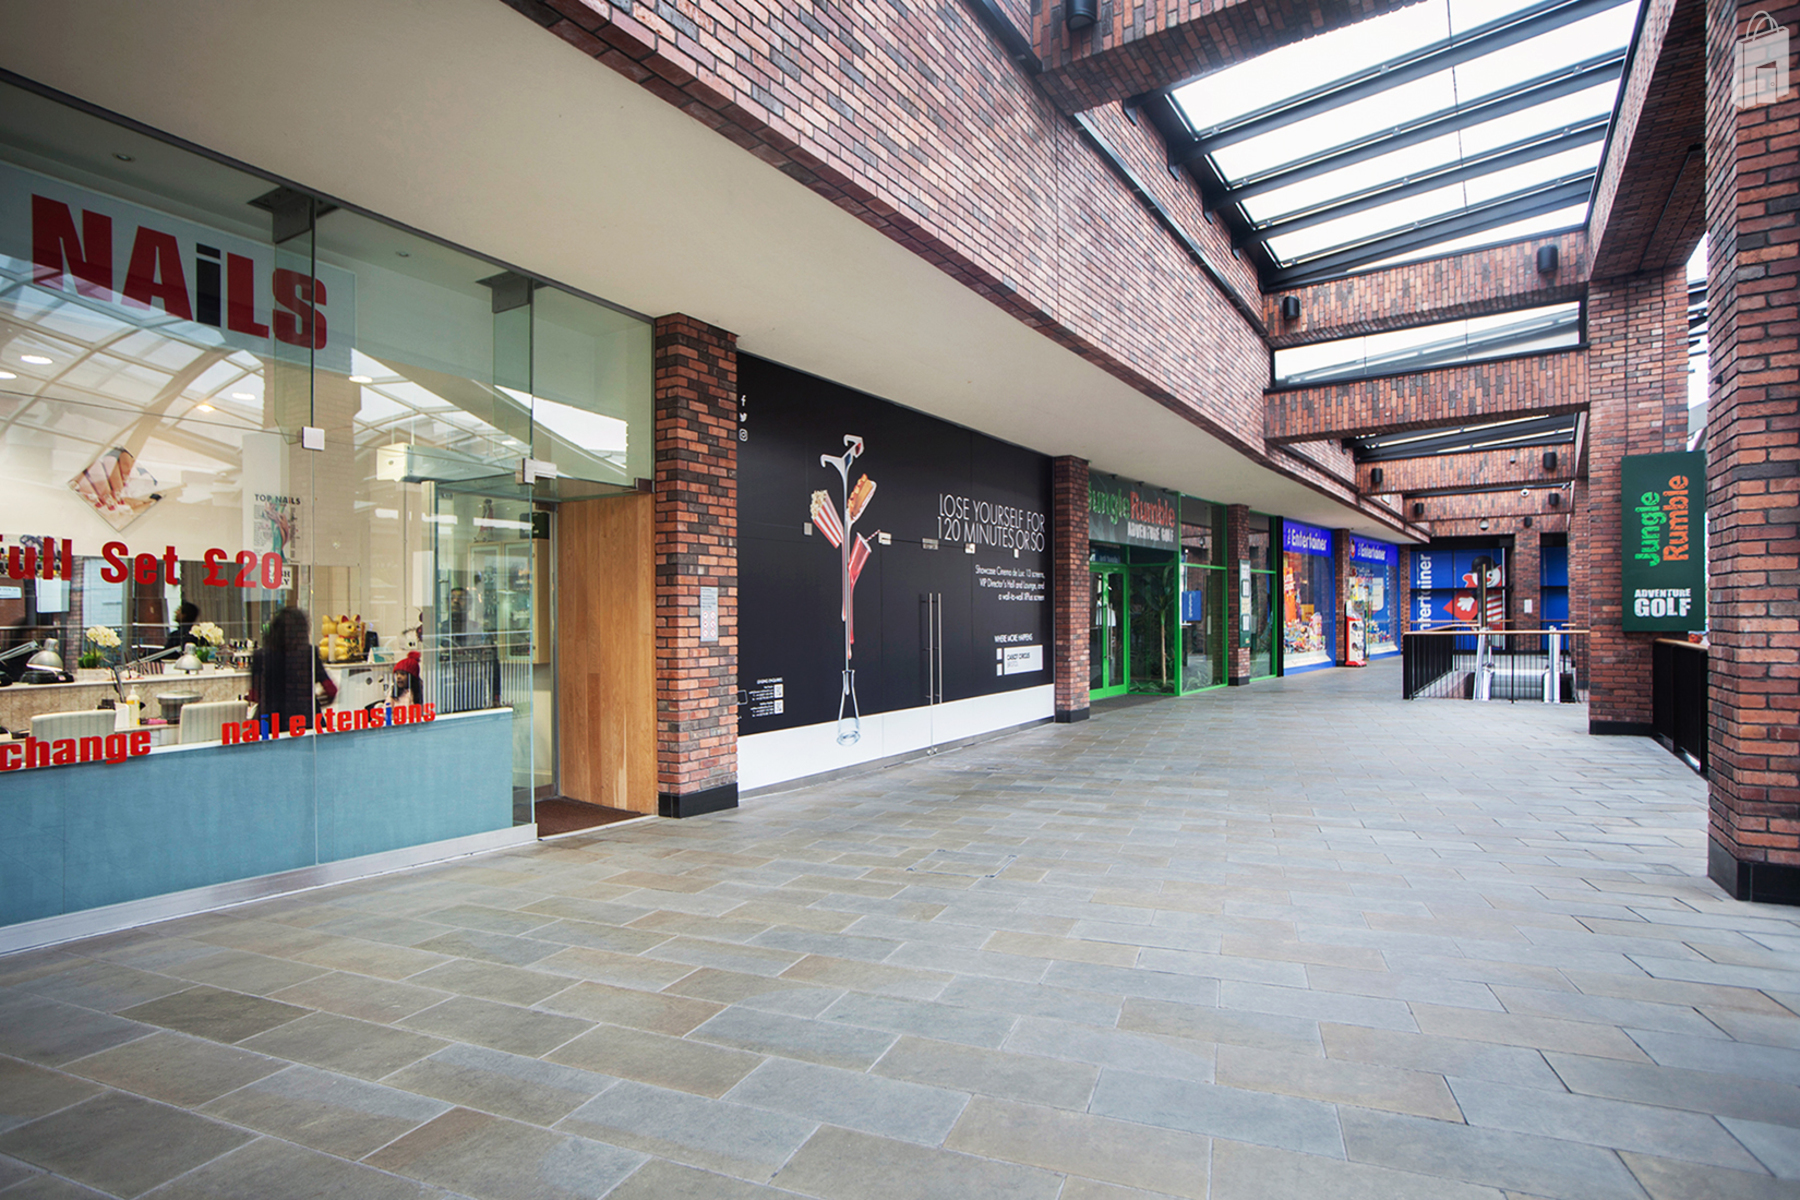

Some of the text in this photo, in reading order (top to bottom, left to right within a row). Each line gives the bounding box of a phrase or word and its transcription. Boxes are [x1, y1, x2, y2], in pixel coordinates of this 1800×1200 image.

[254, 493, 273, 502] TOP
[939, 493, 1045, 533] LOSE YOURSELF FOR
[1130, 491, 1176, 528] Rumble
[937, 516, 1045, 552] 120 MINUTES OR SO
[1634, 491, 1667, 567] Jungle
[1663, 475, 1689, 561] Rumble
[1292, 528, 1327, 551] Entertainer
[0, 534, 72, 581] ull
[101, 541, 179, 586] Set
[202, 547, 283, 590] £20
[1634, 588, 1692, 598] ADVENTURE
[1634, 597, 1692, 618] GOLF
[221, 712, 280, 745] nail
